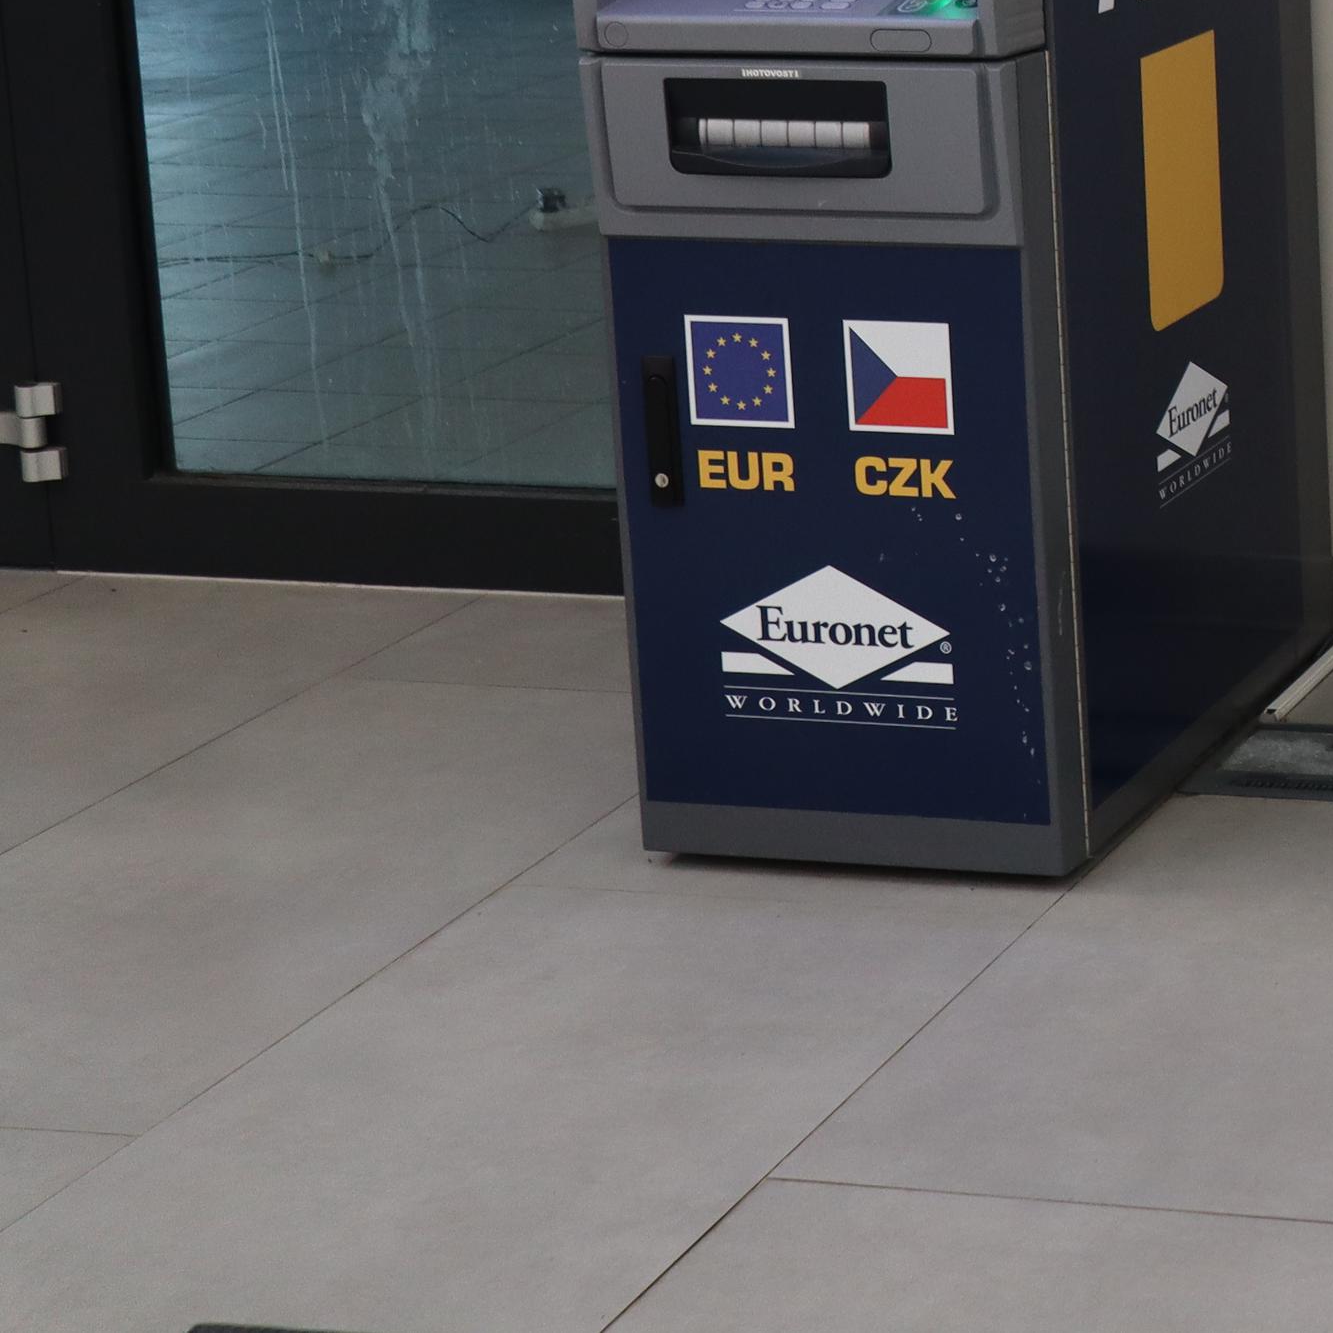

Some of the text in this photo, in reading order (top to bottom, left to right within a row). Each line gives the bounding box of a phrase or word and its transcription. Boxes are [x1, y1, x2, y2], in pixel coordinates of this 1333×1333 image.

[1168, 387, 1218, 439] Euronet
[697, 449, 796, 492] EUR
[854, 456, 957, 499] CZK
[1158, 441, 1232, 500] WORLDWIDE
[755, 604, 916, 650] Euronet
[724, 693, 959, 723] WORLDWIDE
